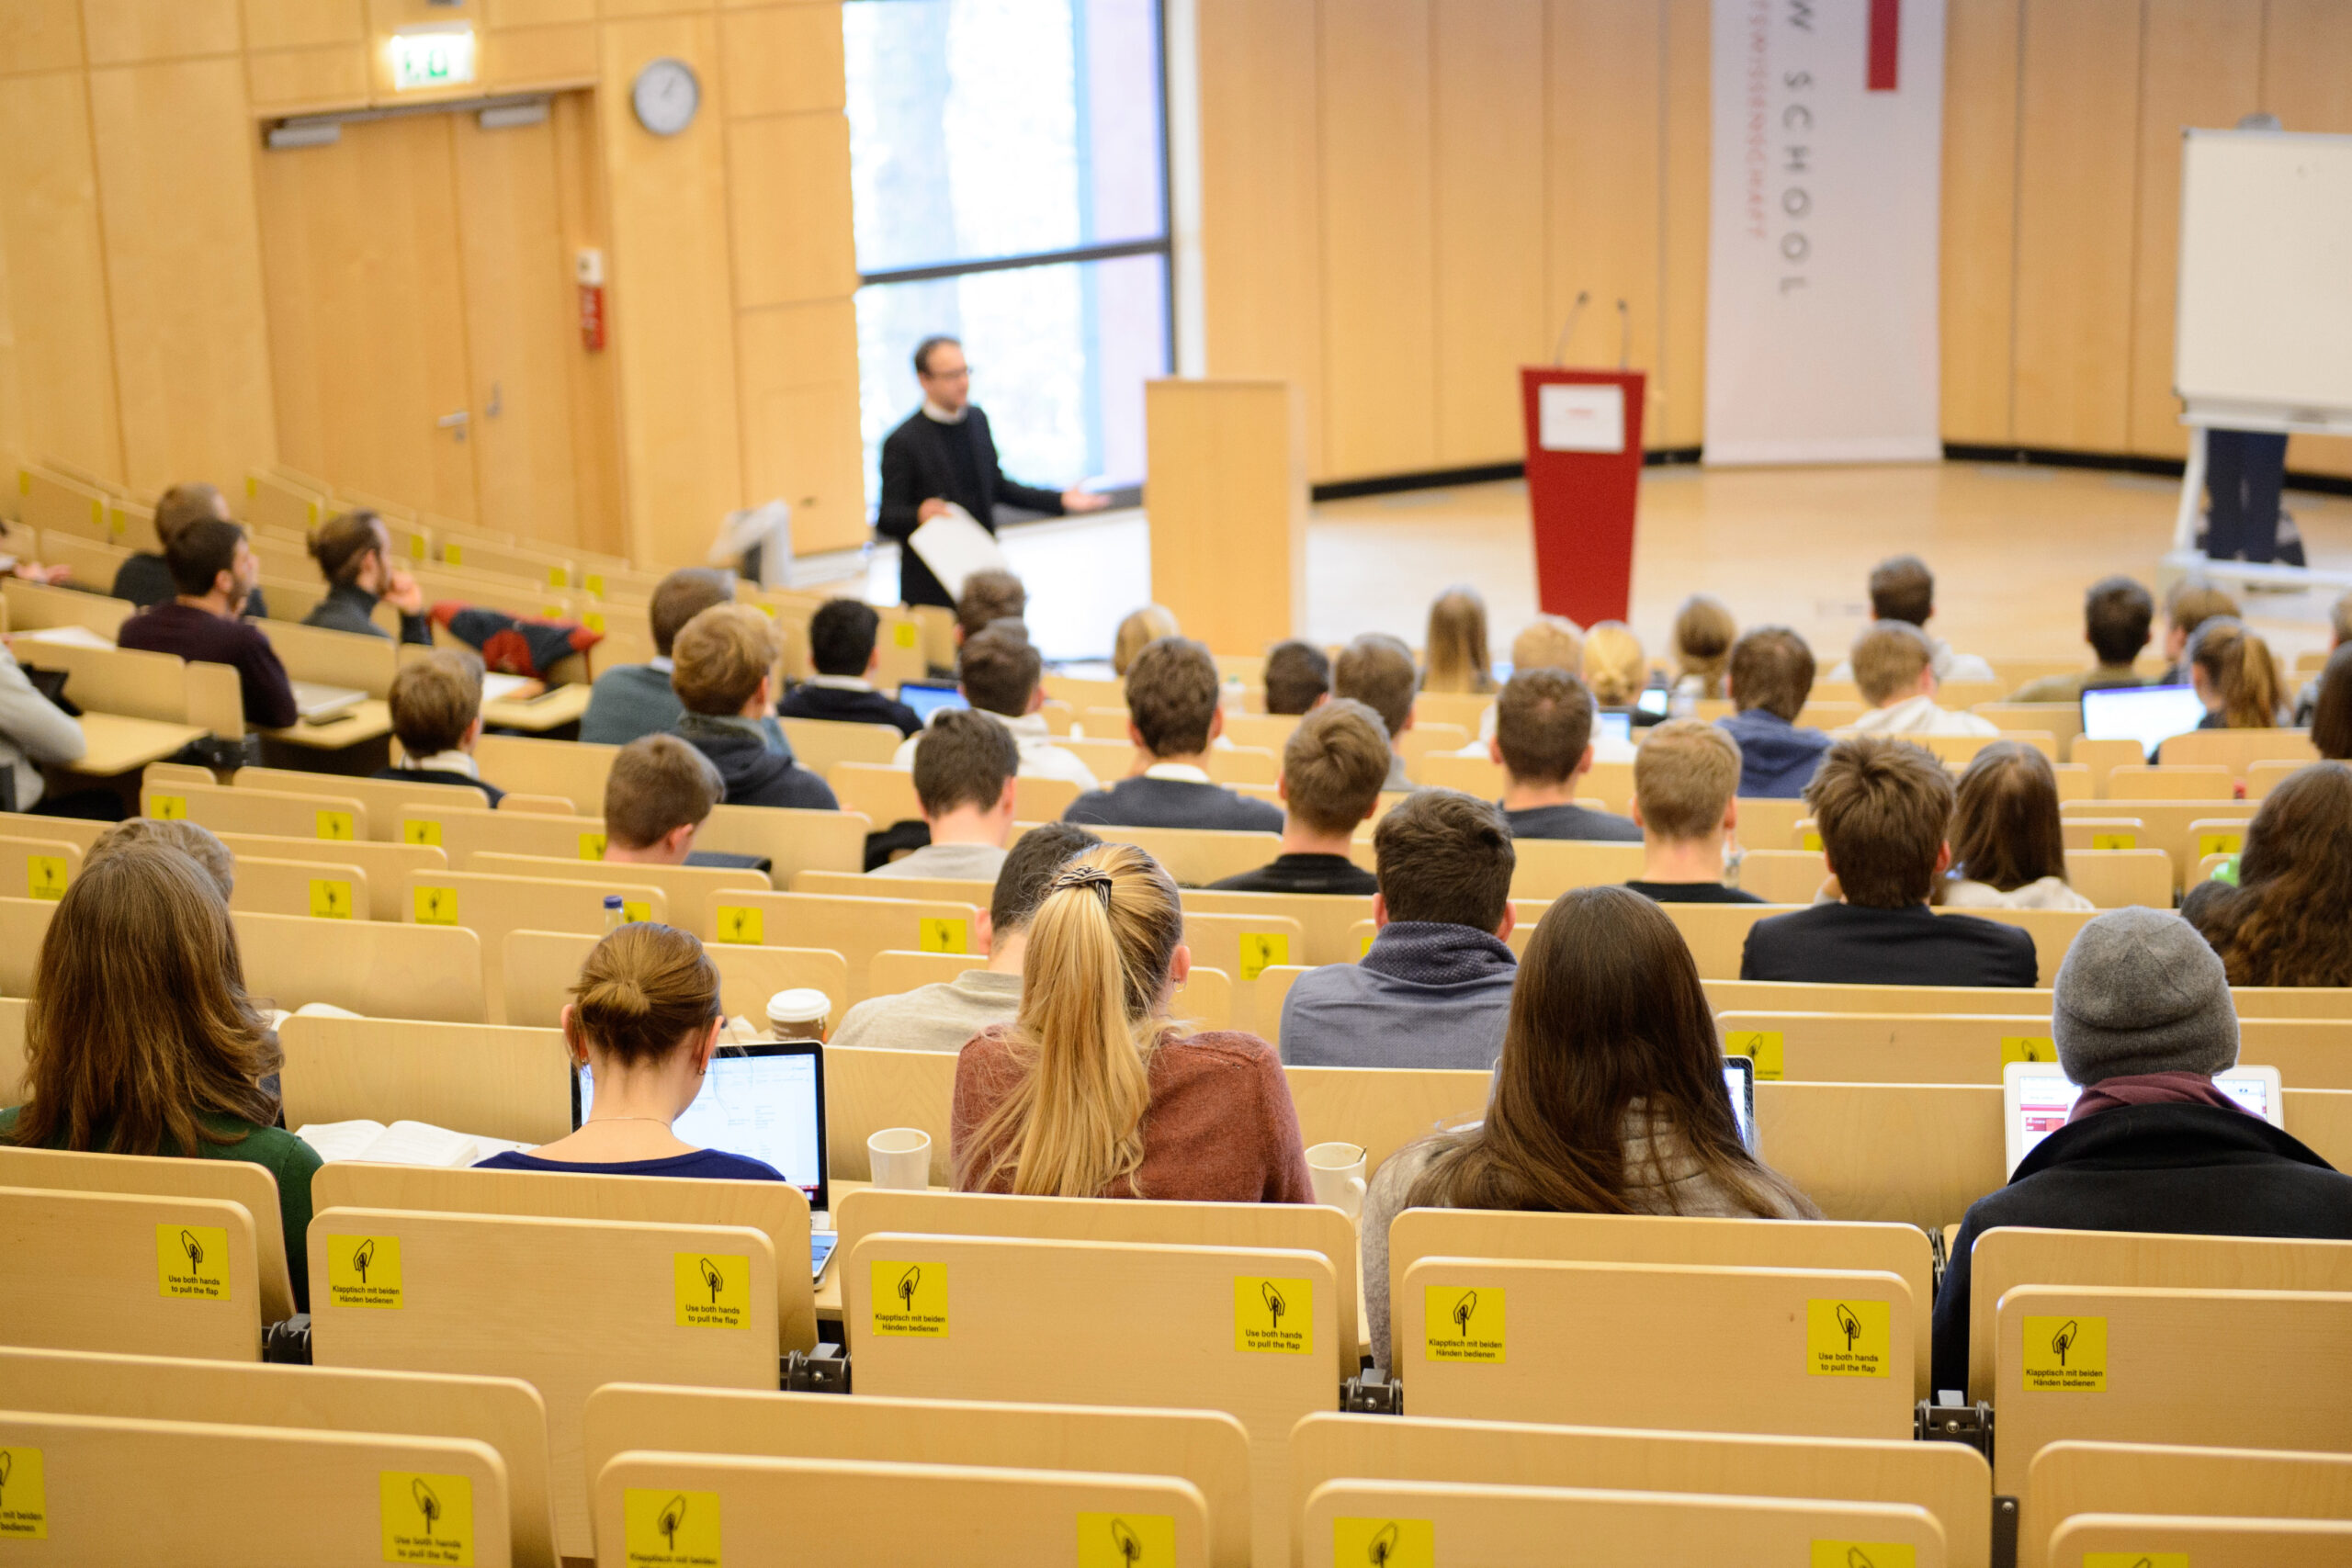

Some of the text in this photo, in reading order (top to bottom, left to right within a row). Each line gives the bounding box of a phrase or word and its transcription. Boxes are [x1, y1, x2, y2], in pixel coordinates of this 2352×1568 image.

[1780, 71, 1814, 295] SCHOOL
[207, 1287, 218, 1296] flap
[725, 1316, 738, 1325] flap
[876, 1314, 910, 1322] Klapptisch
[1287, 1342, 1300, 1350] flap
[1429, 1339, 1464, 1348] Klapptisch
[1861, 1364, 1876, 1373] flap
